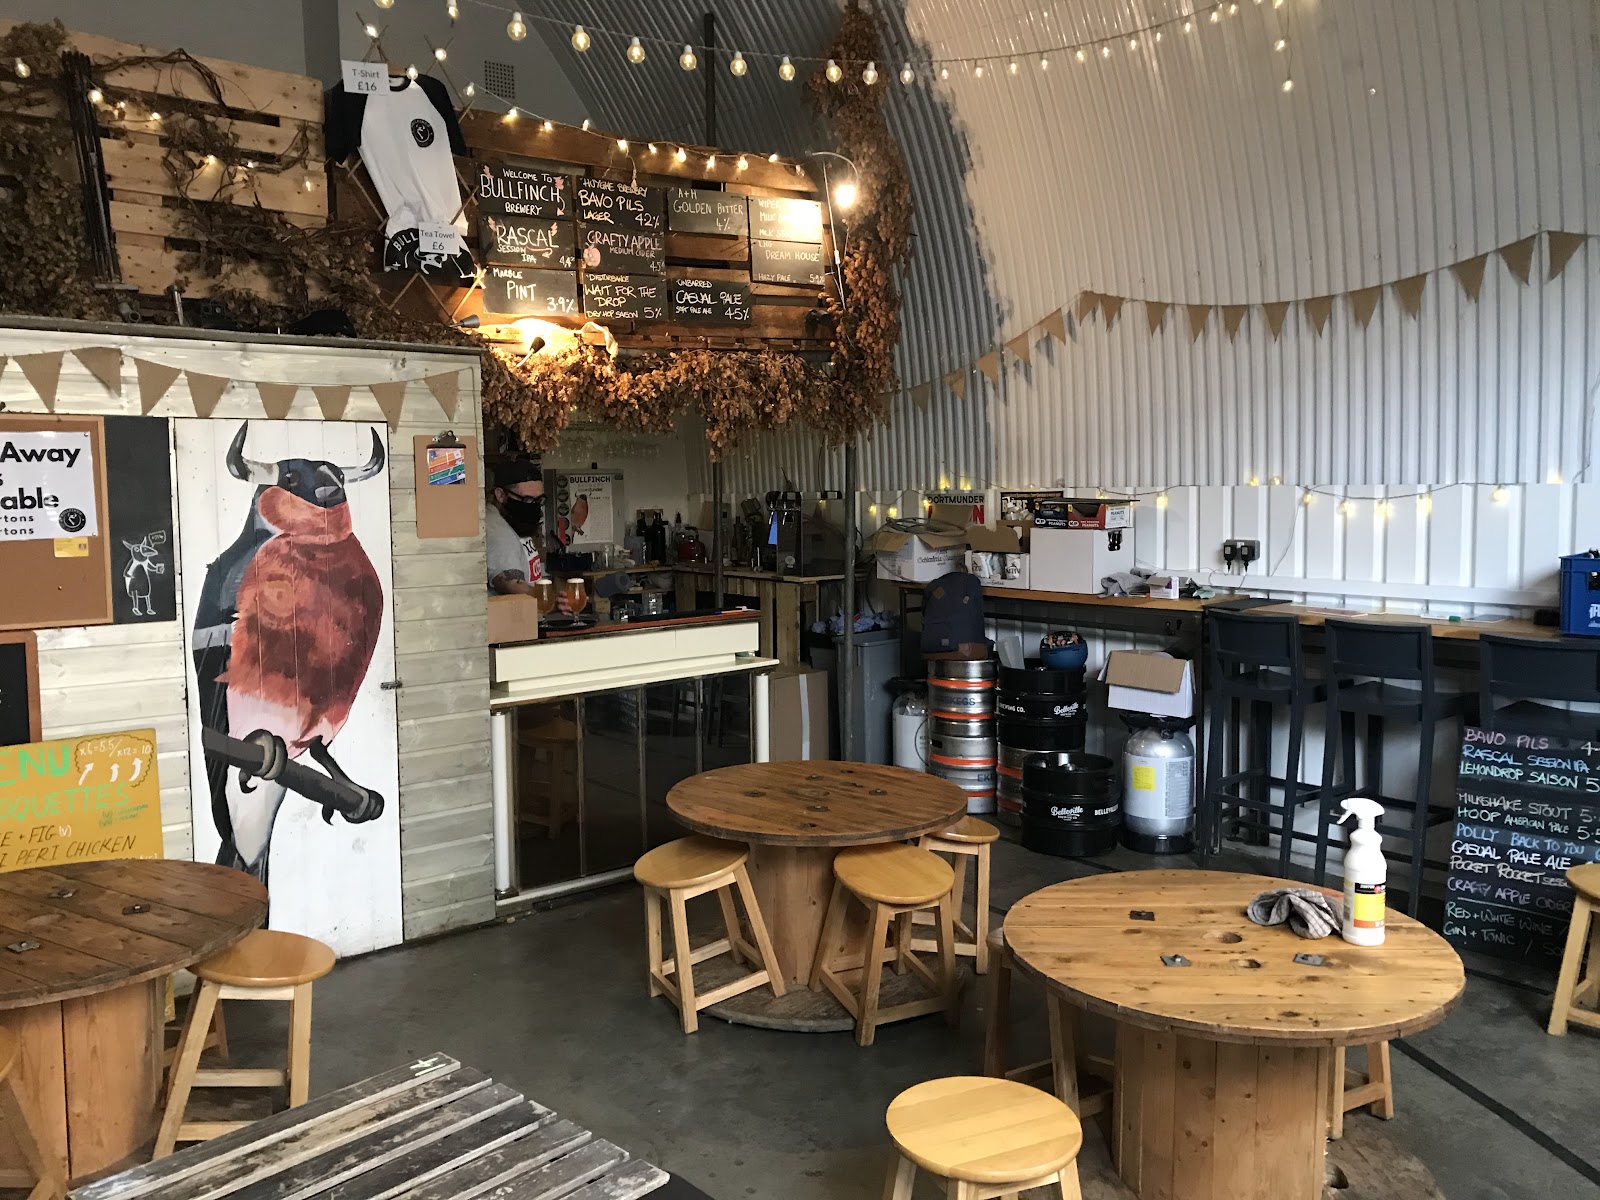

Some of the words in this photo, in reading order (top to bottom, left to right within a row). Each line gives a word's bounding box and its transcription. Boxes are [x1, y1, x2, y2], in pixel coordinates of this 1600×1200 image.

[352, 68, 380, 79] T-Shirt
[357, 80, 377, 92] £16
[503, 168, 538, 181] WELCOME
[541, 173, 553, 183] TO
[479, 173, 560, 202] BULLFINCH
[578, 189, 613, 209] BAVO
[615, 196, 644, 212] PILS
[673, 199, 712, 215] GOLDEN
[717, 203, 744, 216] BITTER
[505, 202, 542, 216] BREWERY
[583, 209, 615, 224] LAGER
[716, 217, 731, 231] 4%
[420, 229, 433, 239] Tea
[434, 230, 455, 240] Towel
[495, 224, 560, 248] RASCAL
[586, 230, 629, 248] CRAFTY
[631, 235, 662, 251] APPLE
[432, 240, 445, 252] £6
[496, 244, 527, 254] SESSION
[609, 247, 635, 257] MEDIUM
[635, 249, 656, 259] CIDER
[521, 253, 537, 264] IPA
[765, 250, 791, 261] DREAM
[794, 251, 820, 262] HOUSE
[493, 267, 523, 280] MARBLE
[758, 272, 776, 282] HAZY
[776, 273, 791, 283] PALE
[506, 280, 537, 302] PINT
[584, 285, 612, 297] WAIT
[614, 285, 637, 298] FOR
[638, 286, 657, 298] THE
[677, 279, 713, 289] UNBARRED
[546, 296, 575, 313] 3.9%
[593, 296, 627, 308] DROP
[676, 290, 718, 305] CASUAL
[720, 291, 743, 306] PALE
[643, 307, 662, 319] 5%
[0, 441, 81, 468] Away
[927, 495, 984, 504] DORTMUNDER
[1053, 702, 1079, 715] Belleville
[1464, 728, 1506, 745] BAVO
[1516, 735, 1549, 750] PILS
[1462, 744, 1523, 766] RASCAL
[1527, 755, 1571, 770] SESSION
[1573, 758, 1590, 773] IPA
[1460, 761, 1524, 780] LEMONDROP
[1527, 771, 1579, 789] SAISON
[1050, 806, 1084, 817] Belleville
[1458, 792, 1522, 811] MILKSHAKE
[1528, 803, 1573, 820] STOUT
[1457, 806, 1501, 823] HOOP
[1504, 814, 1545, 830] AMERICAN
[1548, 821, 1570, 834] PALE
[28, 825, 58, 845] FIG
[1456, 822, 1500, 842] POLLY
[1510, 832, 1540, 850] BACK
[1544, 839, 1561, 851] TO
[1564, 842, 1585, 855] YOU
[16, 845, 59, 866] PERI
[65, 835, 137, 858] CHICKEN
[1451, 840, 1502, 860] CASUAL
[1506, 848, 1541, 866] PALE
[1544, 855, 1571, 870] ALE
[1450, 855, 1495, 873] POCKET
[1497, 862, 1546, 884] ROCKET
[1447, 876, 1492, 897] CRAFTY
[1494, 888, 1531, 905] APPLE
[1535, 896, 1572, 914] CIDER
[1445, 901, 1471, 919] RED
[1480, 909, 1515, 927] WHITE
[1519, 917, 1552, 936] WINE
[1442, 921, 1467, 937] GIN
[1480, 928, 1516, 945] TONIC
